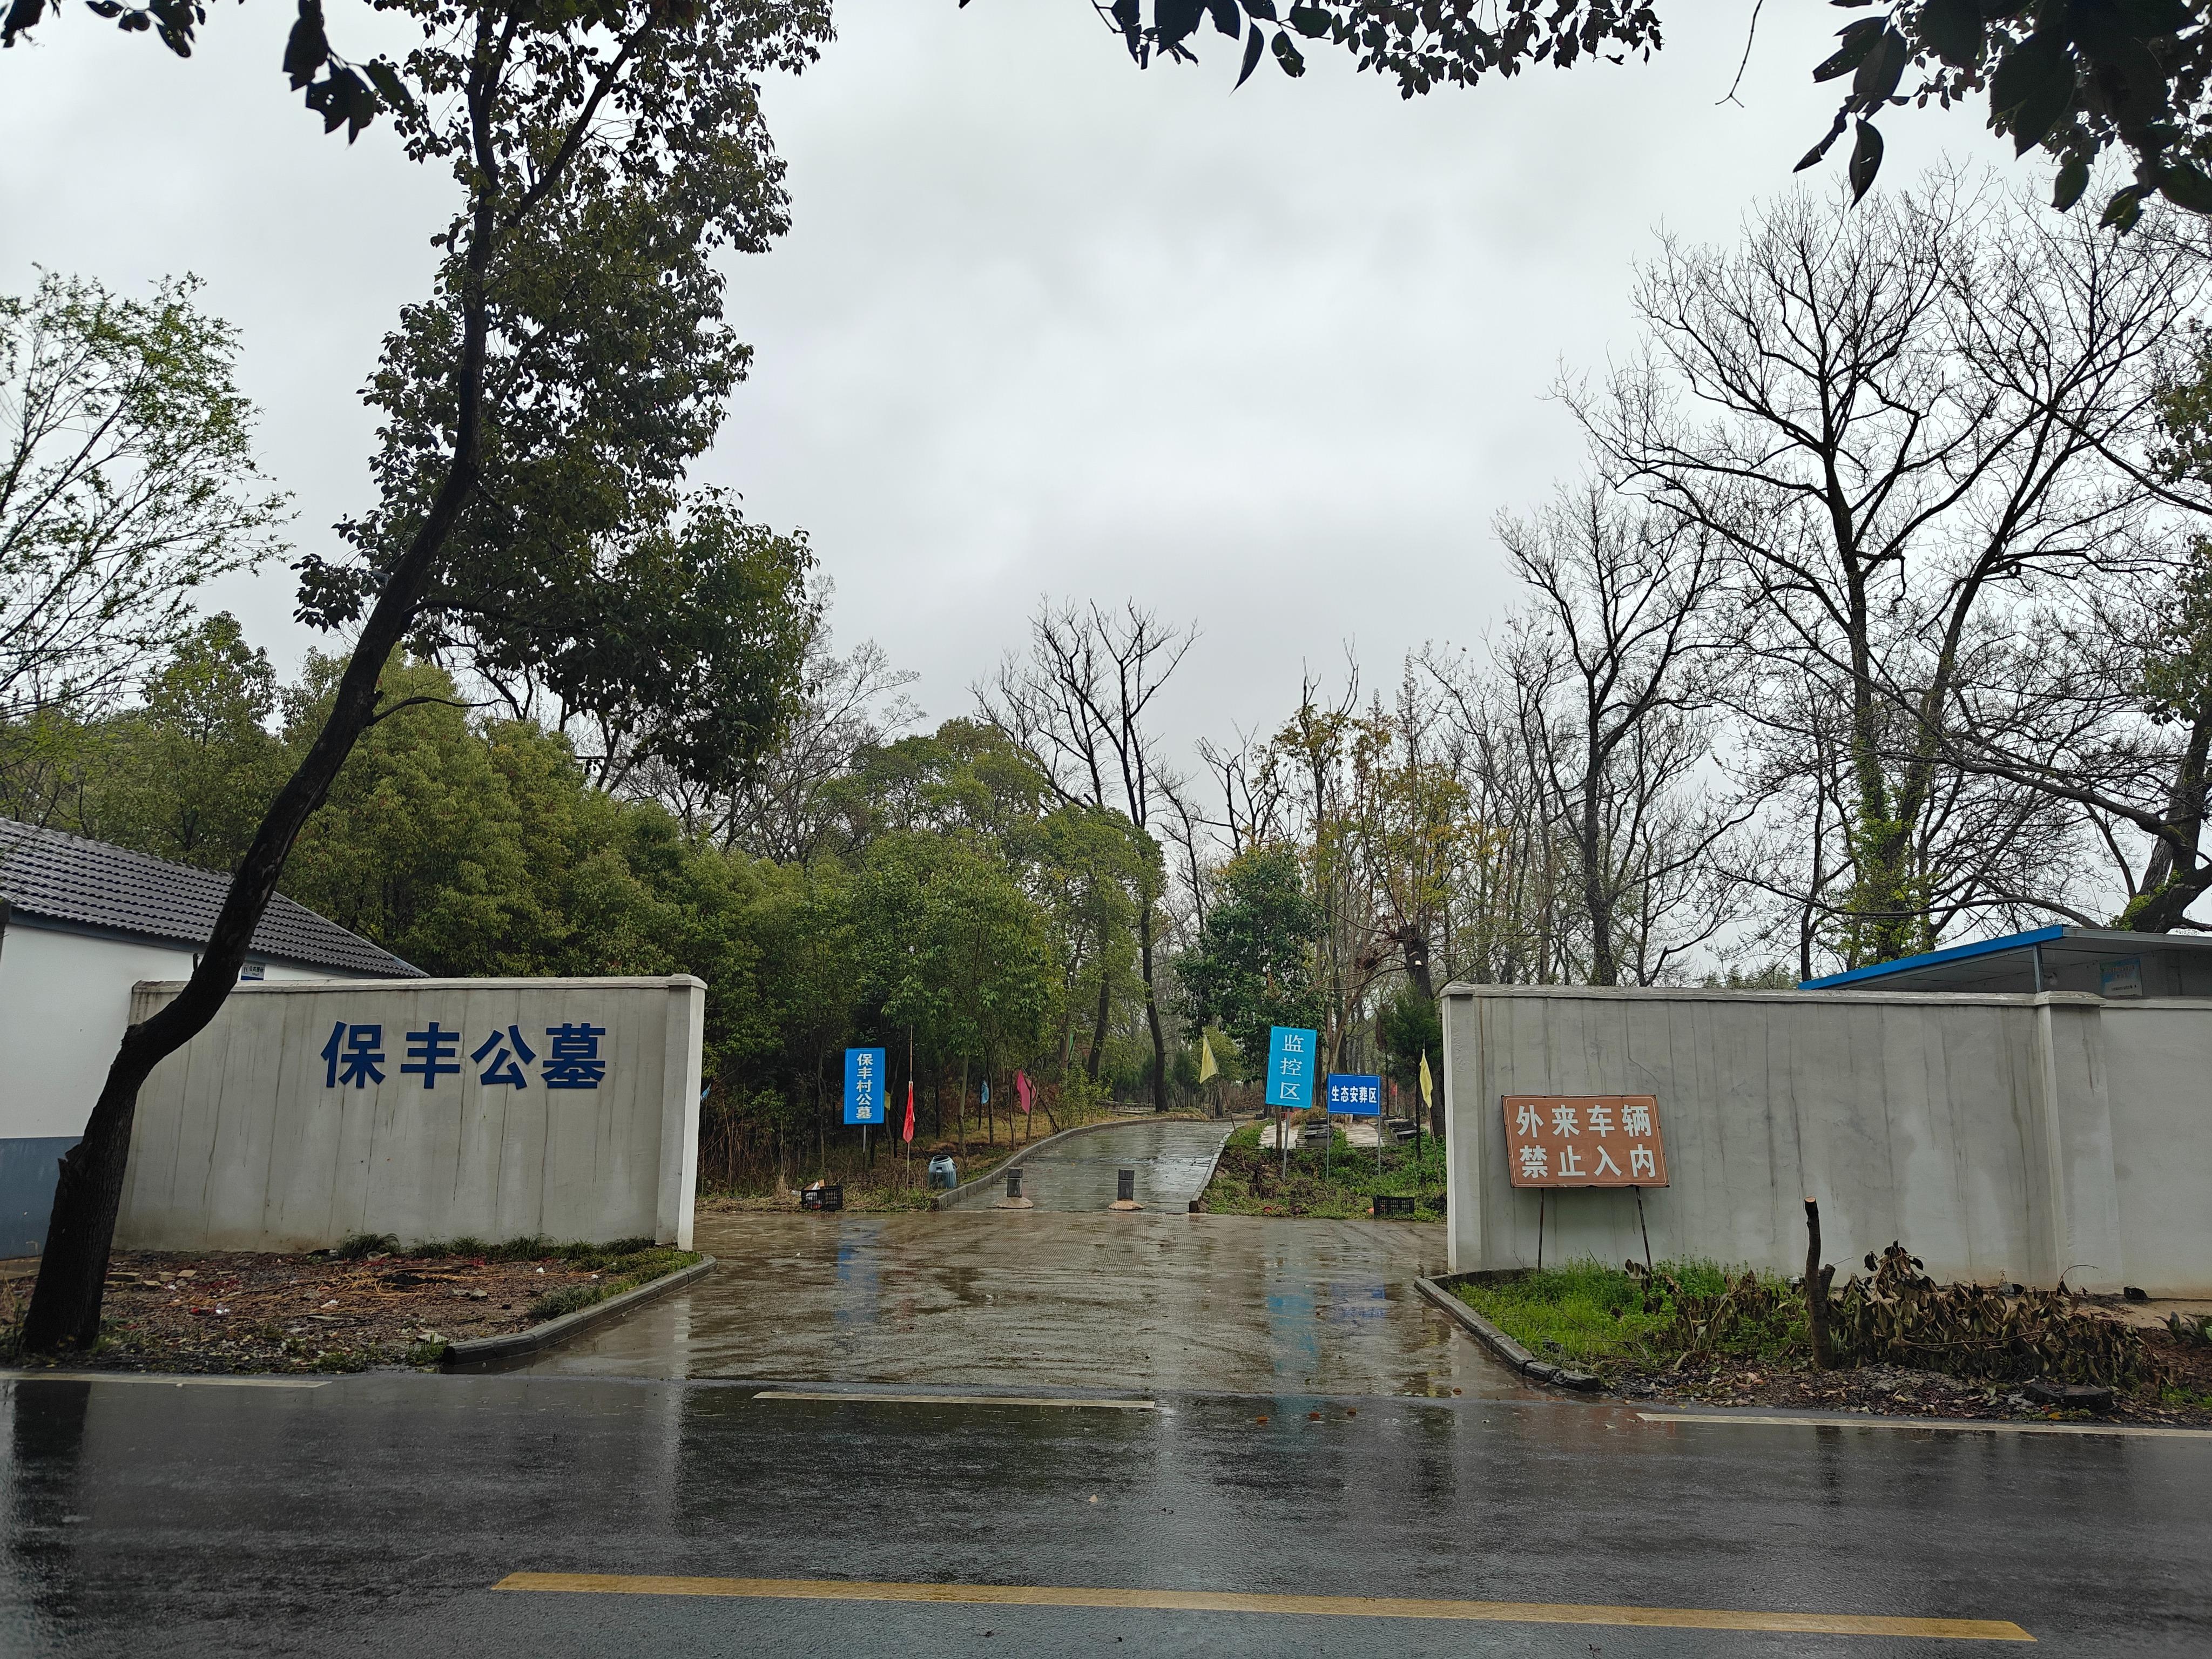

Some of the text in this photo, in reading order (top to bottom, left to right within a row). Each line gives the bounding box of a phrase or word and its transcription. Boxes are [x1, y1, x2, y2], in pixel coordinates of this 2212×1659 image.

[321, 1021, 606, 1090] 保丰公墓
[1279, 1034, 1304, 1101] 监控区
[855, 1053, 873, 1120] 保丰村公墓
[1331, 1085, 1377, 1103] 生态安葬区
[1515, 1104, 1652, 1138] 外来车辆
[1519, 1144, 1656, 1178] 禁止入内
